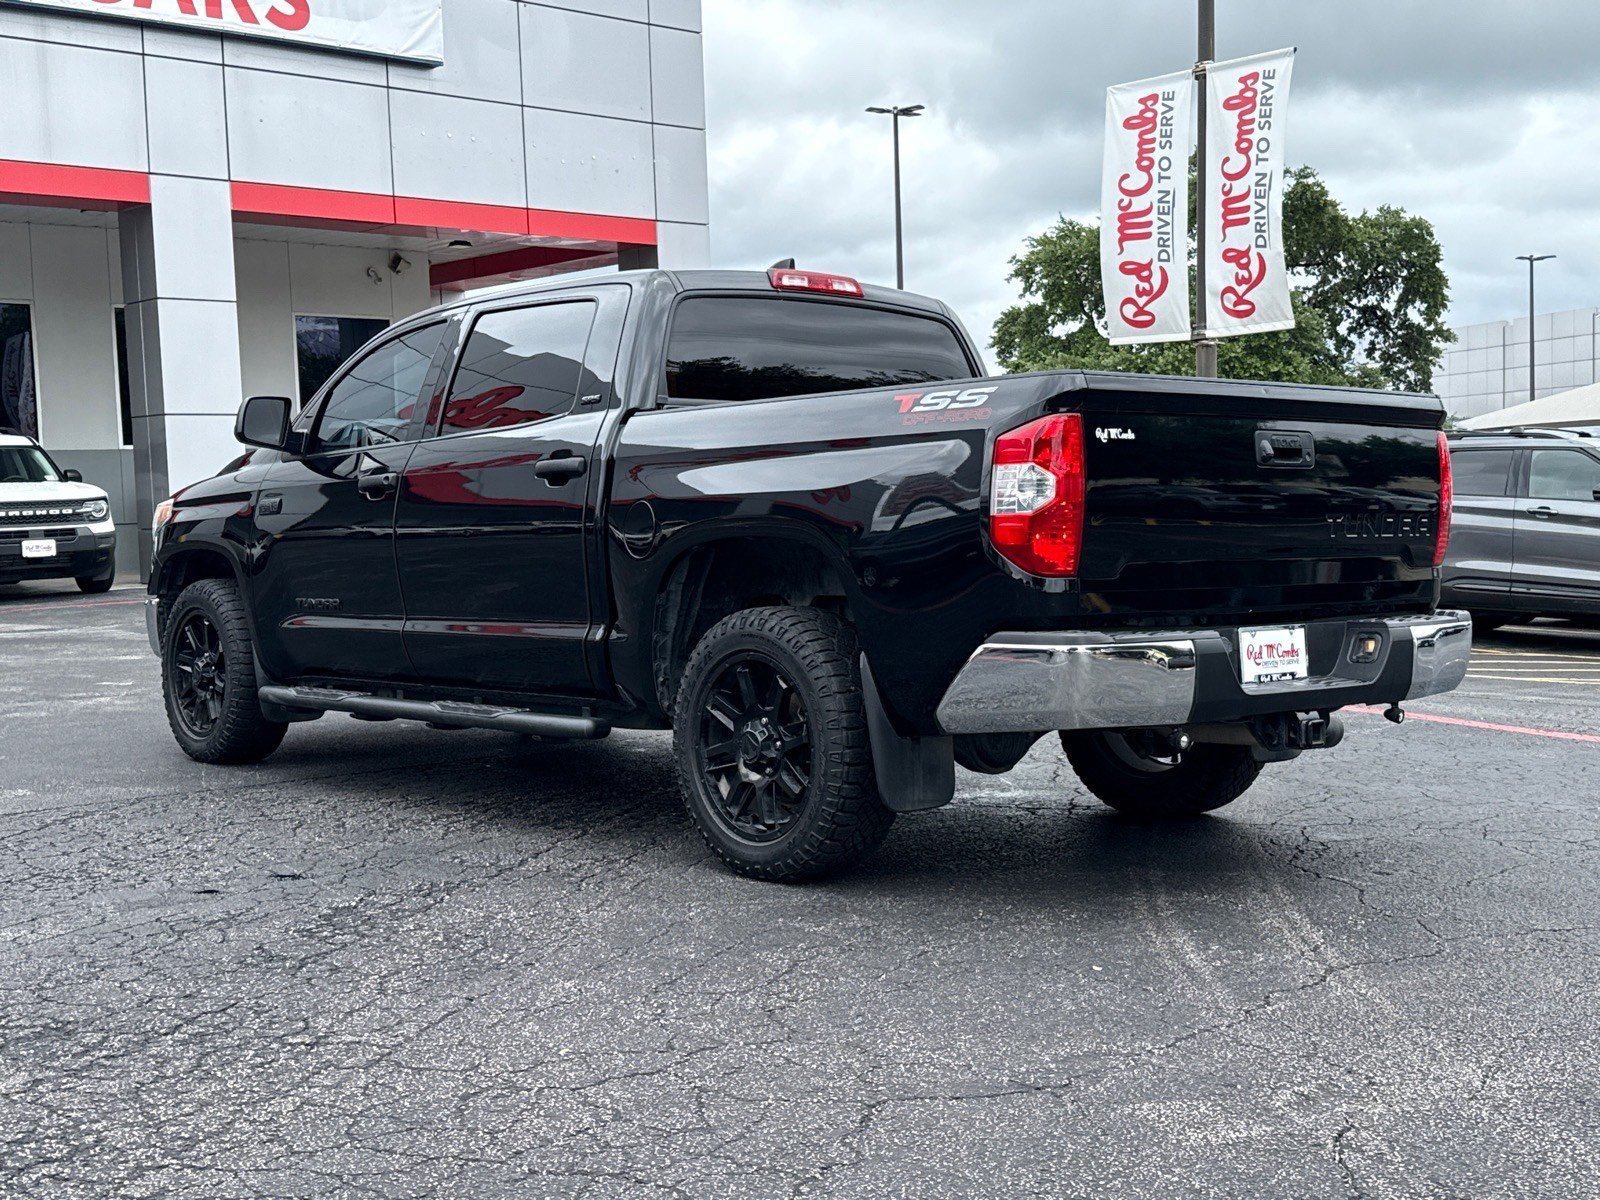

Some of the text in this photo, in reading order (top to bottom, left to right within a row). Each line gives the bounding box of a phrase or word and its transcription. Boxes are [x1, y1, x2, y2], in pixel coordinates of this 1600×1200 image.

[1117, 93, 1169, 329] Red McCombs
[1157, 90, 1175, 263] DRIVEN TO SERVE
[1220, 71, 1267, 320] Red McCombs
[1255, 68, 1276, 249] DRIVEN TO SERVE
[894, 386, 999, 413] TSS
[1326, 513, 1432, 538] TUNDRA
[1246, 643, 1263, 667] Red
